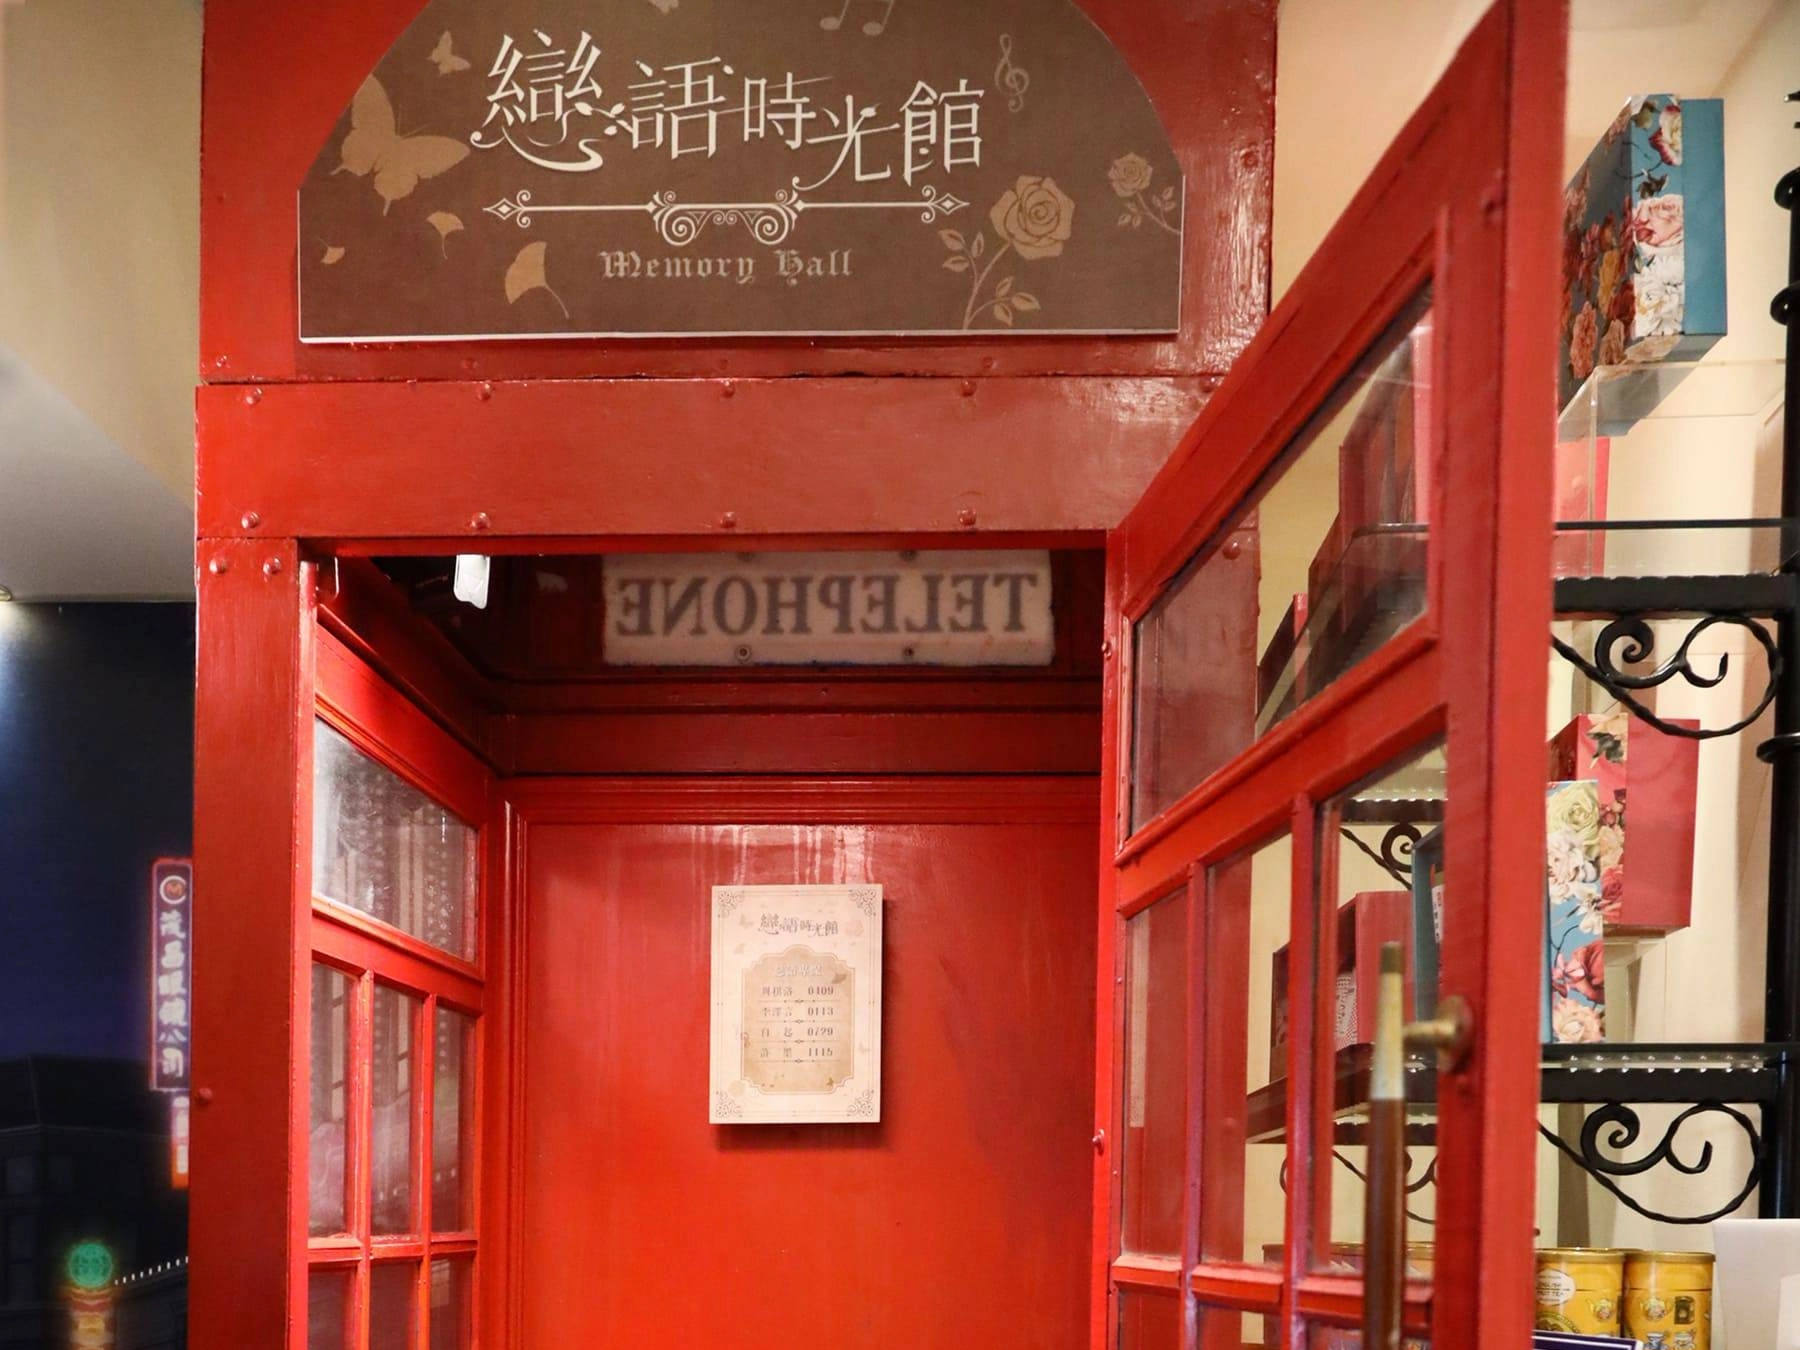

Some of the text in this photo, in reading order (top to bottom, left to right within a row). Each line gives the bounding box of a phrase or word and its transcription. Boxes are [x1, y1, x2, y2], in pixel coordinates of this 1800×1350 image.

[470, 28, 985, 190] 戀語時光館
[598, 248, 853, 286] Memory Hall
